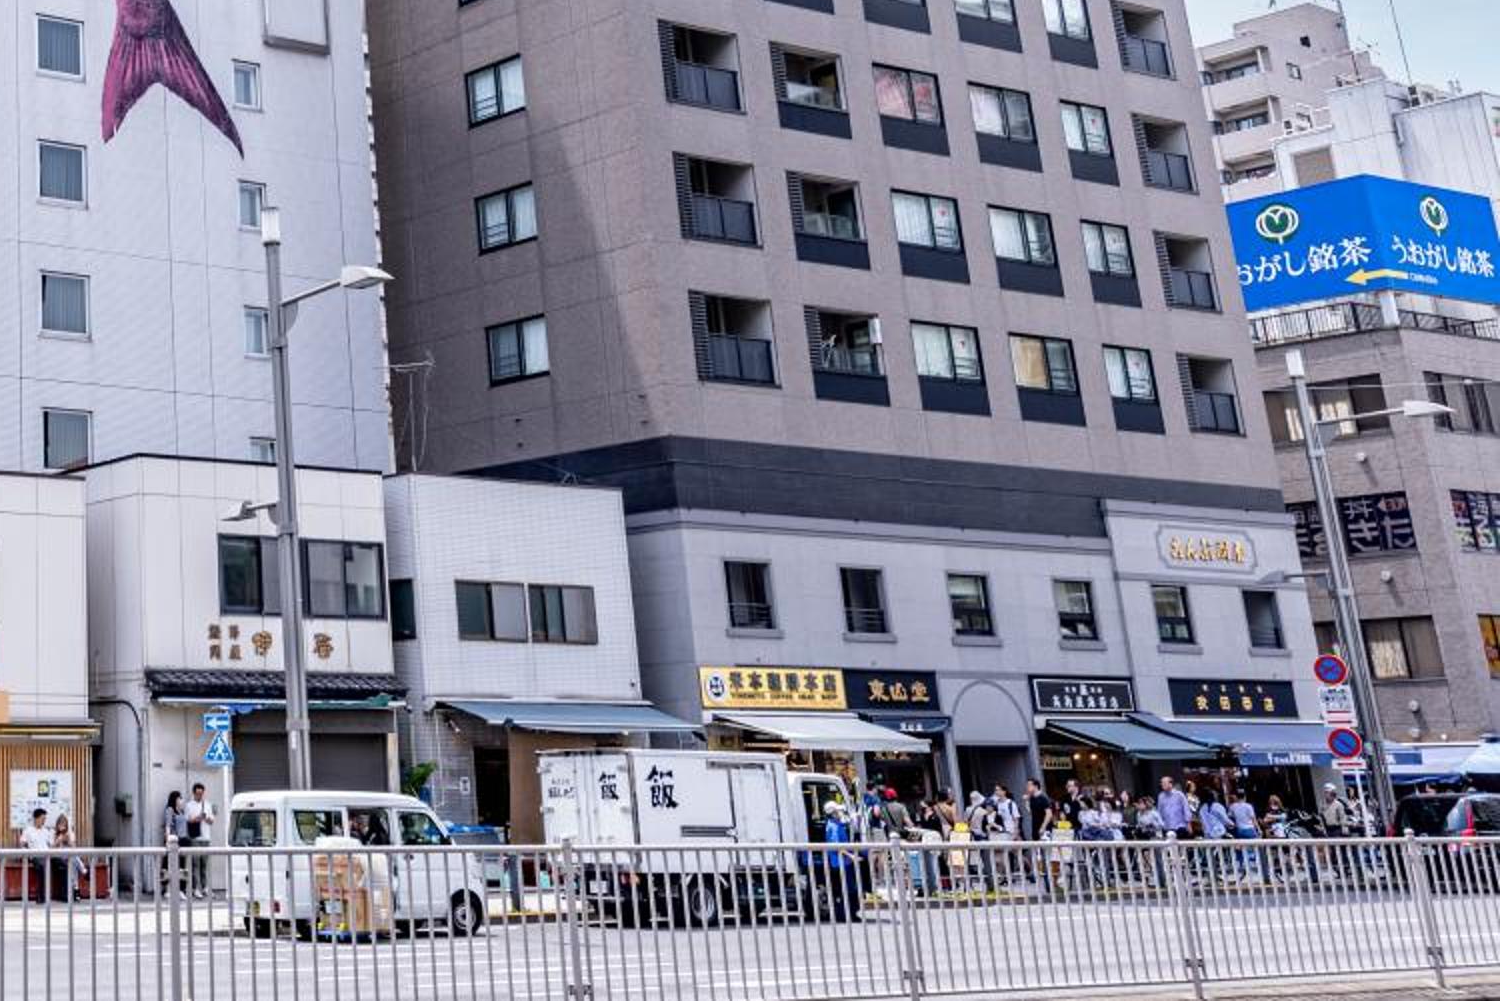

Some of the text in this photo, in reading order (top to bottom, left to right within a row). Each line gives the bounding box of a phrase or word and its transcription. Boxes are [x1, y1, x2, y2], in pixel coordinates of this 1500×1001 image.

[1391, 235, 1495, 278] うおがし銘茶
